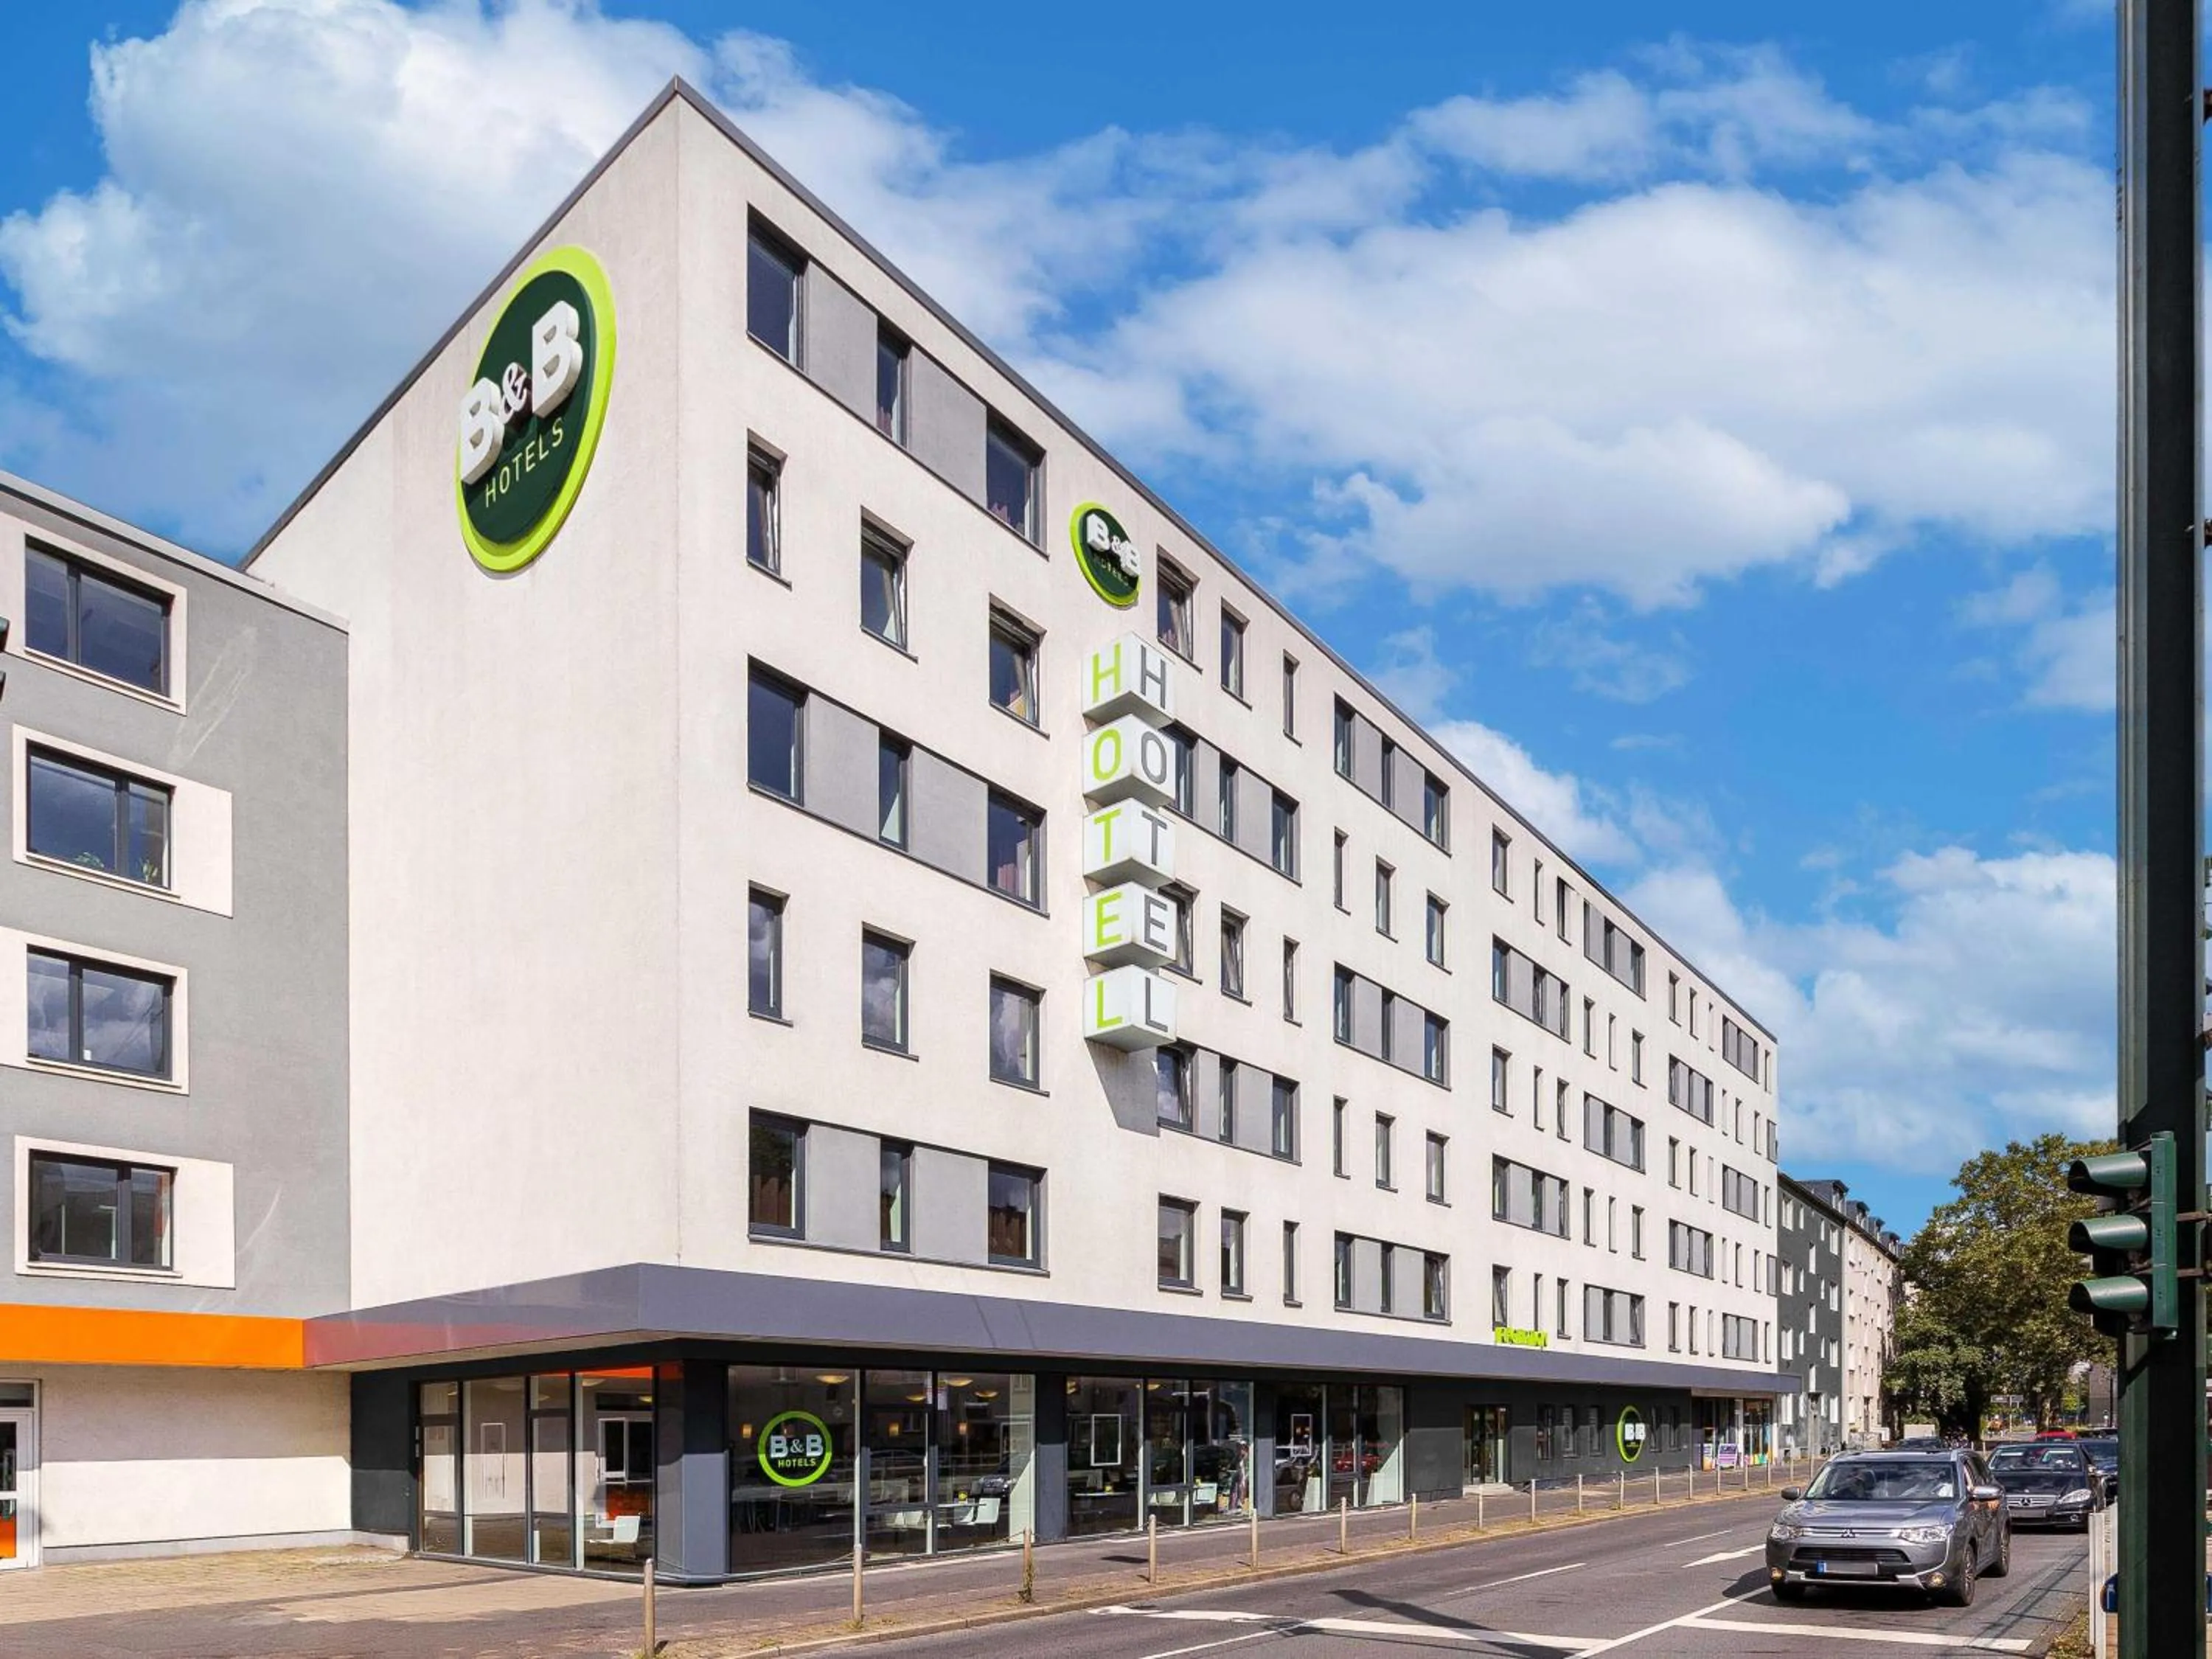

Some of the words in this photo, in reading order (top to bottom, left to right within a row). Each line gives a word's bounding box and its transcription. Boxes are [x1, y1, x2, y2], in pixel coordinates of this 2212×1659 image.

[460, 300, 583, 484] B&B
[484, 417, 565, 507] HOTELS
[1086, 513, 1142, 577] B&B
[1092, 642, 1124, 1029] HOTEL
[1139, 644, 1169, 1032] HOTEL
[770, 1434, 824, 1458] B&B
[778, 1458, 816, 1468] HOTELS
